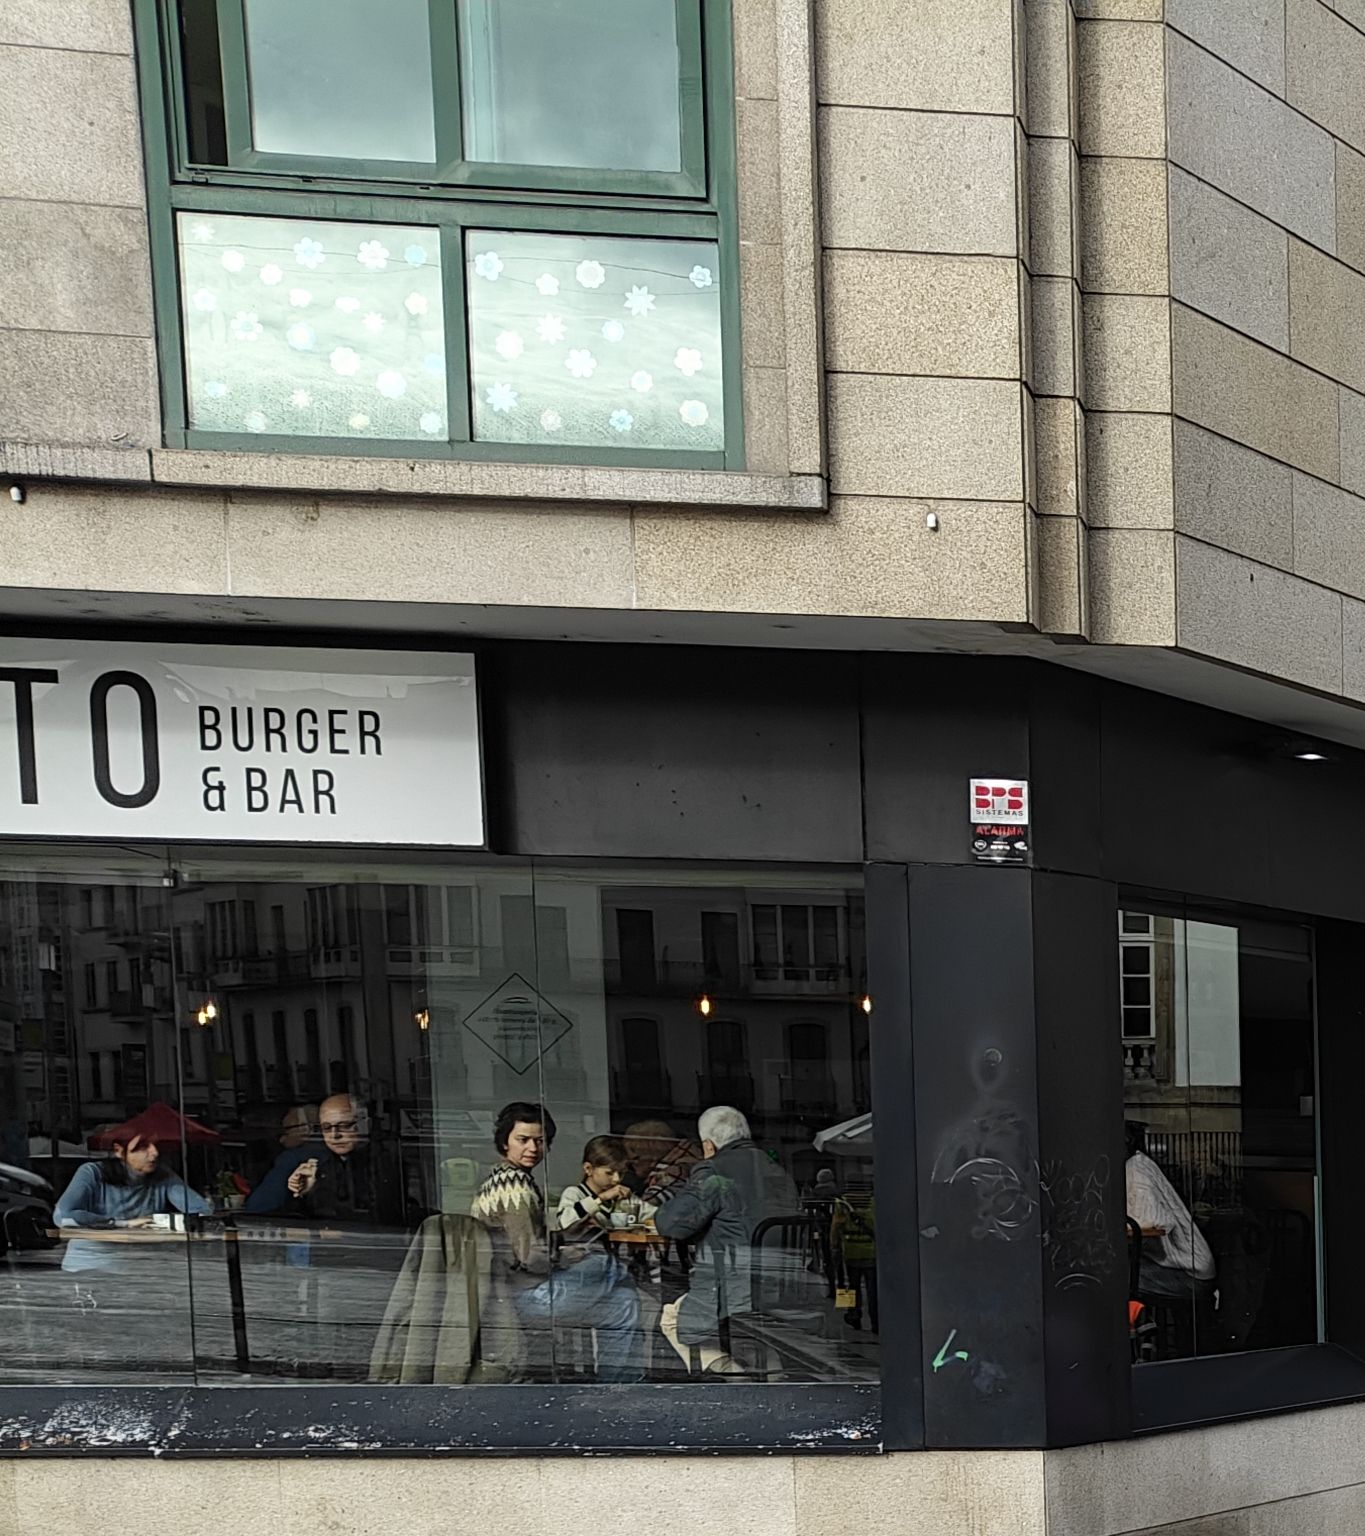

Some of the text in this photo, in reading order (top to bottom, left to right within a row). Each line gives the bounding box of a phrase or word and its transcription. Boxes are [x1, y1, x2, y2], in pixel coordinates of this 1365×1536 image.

[198, 705, 382, 756] BURGER
[201, 766, 337, 815] & BAR
[976, 809, 1024, 817] SISTEMAS
